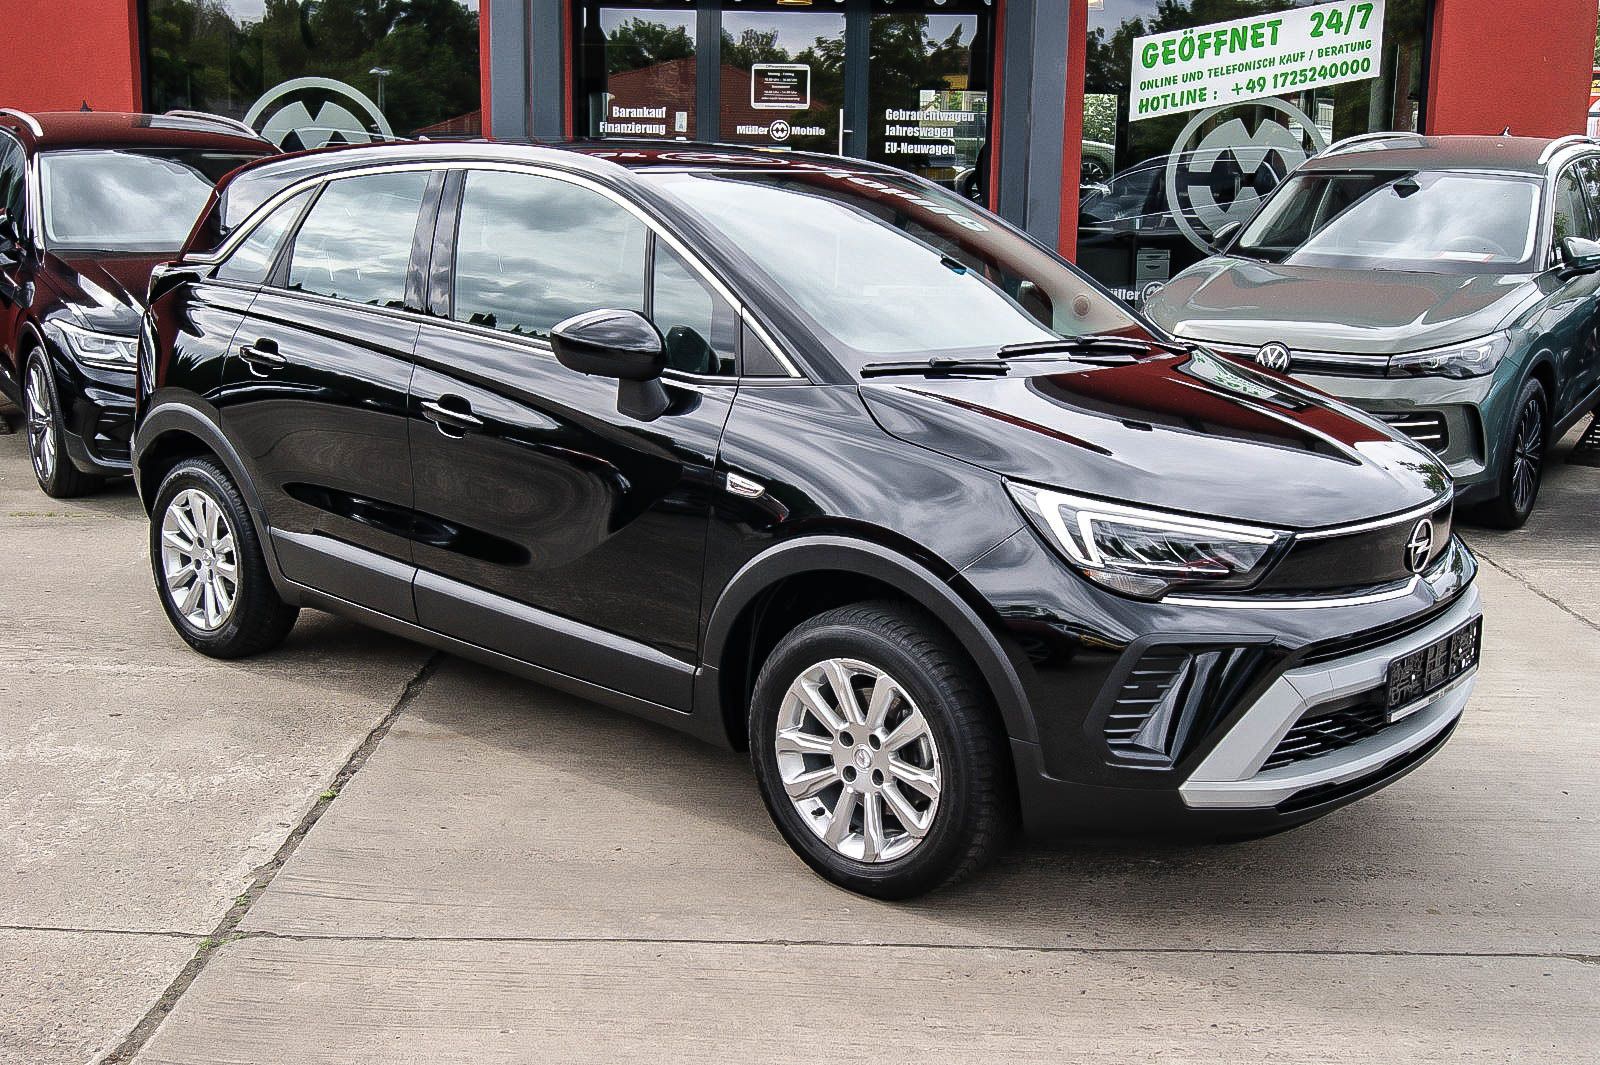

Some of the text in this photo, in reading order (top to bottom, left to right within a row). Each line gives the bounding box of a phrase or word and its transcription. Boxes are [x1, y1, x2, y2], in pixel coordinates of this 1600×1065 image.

[1141, 2, 1374, 69] GEÖFFNET 24/7
[1139, 75, 1178, 91] ONLINE
[1181, 71, 1204, 83] UND
[1207, 57, 1276, 79] TELEFONISCH
[1279, 52, 1306, 66] KAUF
[1317, 39, 1372, 58] BERATUNG
[1138, 86, 1208, 114] HOTLINE
[1231, 76, 1267, 96] +49
[1272, 57, 1371, 89] 1725240000
[612, 106, 667, 119] Barankauf
[885, 109, 975, 123] Gebrauchtwagen
[599, 121, 666, 135] Finanzierung
[736, 124, 826, 136] Müller Mobile
[885, 124, 954, 138] Jahreswagen
[885, 142, 955, 156] EU-Neuwagen
